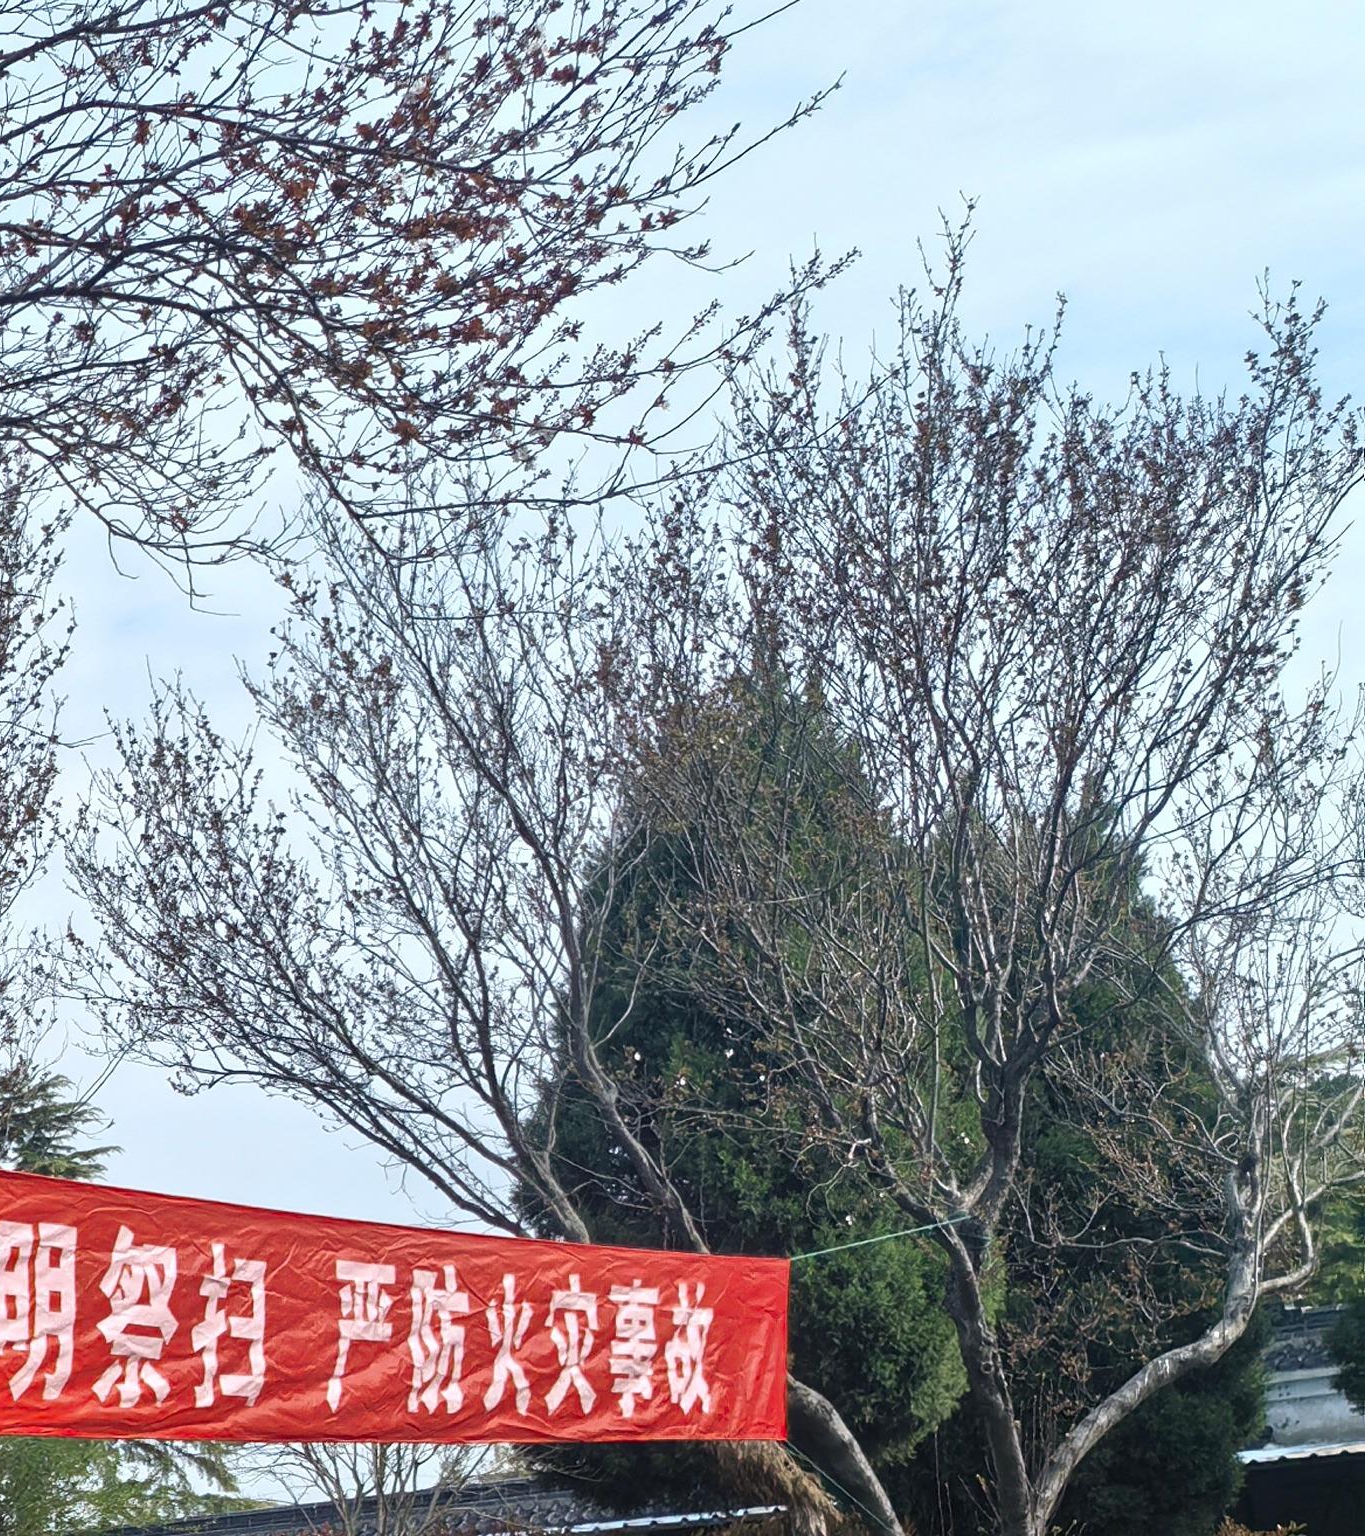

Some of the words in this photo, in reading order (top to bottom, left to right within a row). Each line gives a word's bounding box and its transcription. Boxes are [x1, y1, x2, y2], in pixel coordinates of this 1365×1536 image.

[327, 1260, 713, 1418] 严防火灾事故
